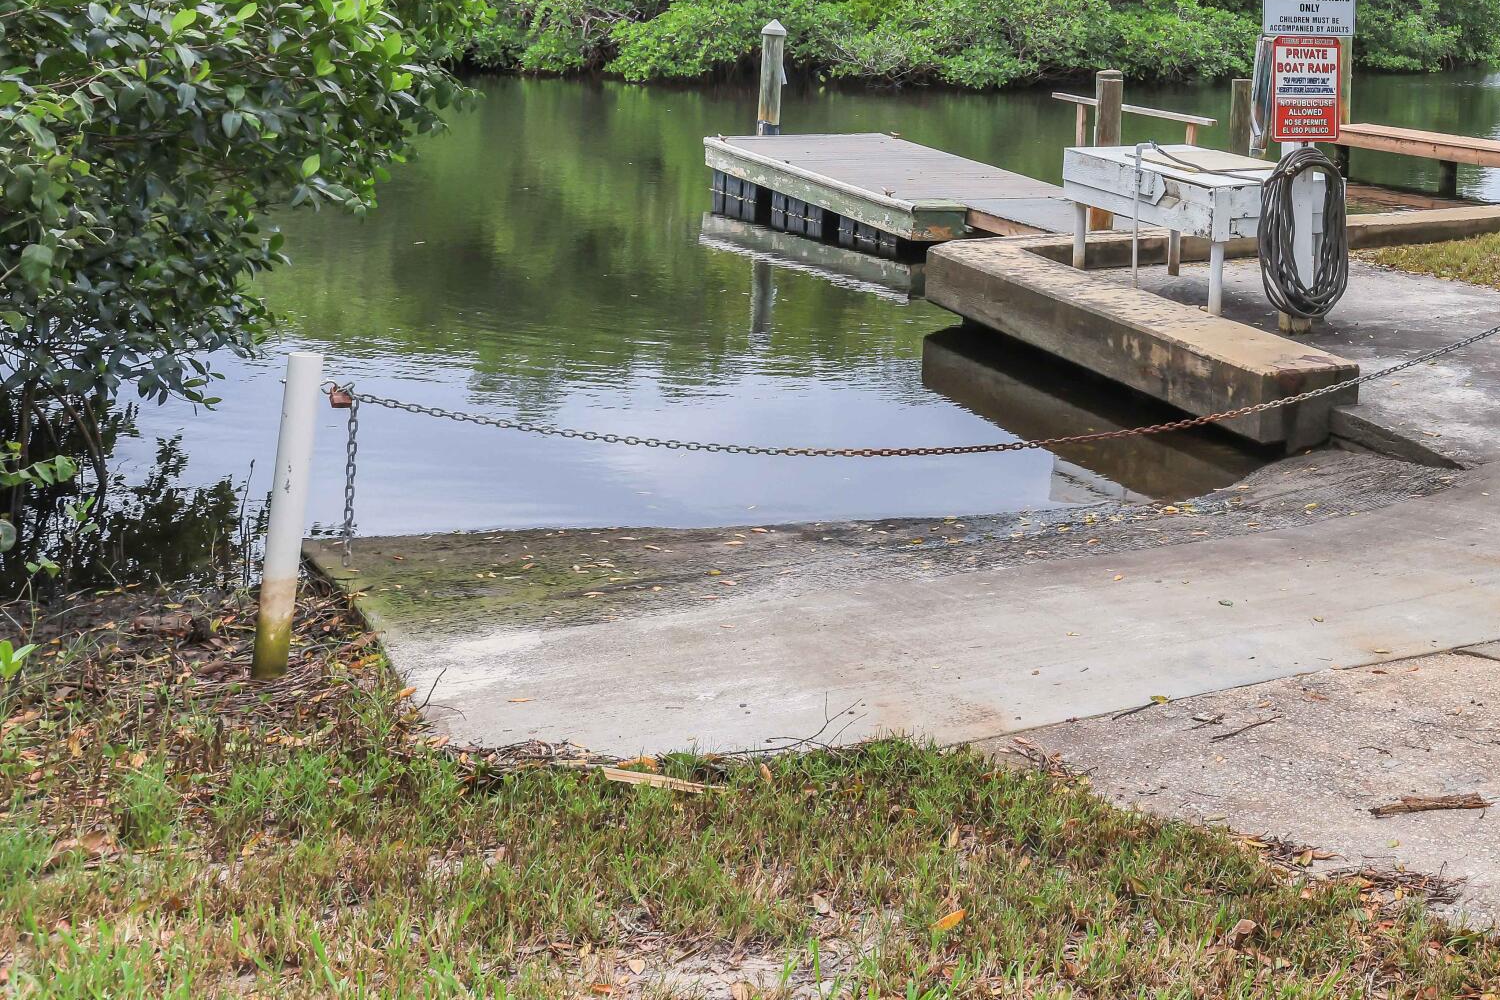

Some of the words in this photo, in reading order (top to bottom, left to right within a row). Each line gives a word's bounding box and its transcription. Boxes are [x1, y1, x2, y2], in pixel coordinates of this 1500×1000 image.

[1300, 4, 1320, 12] ONLY
[1286, 48, 1327, 59] PRIVATE
[1277, 62, 1304, 73] BOAT
[1308, 63, 1336, 74] RAMP
